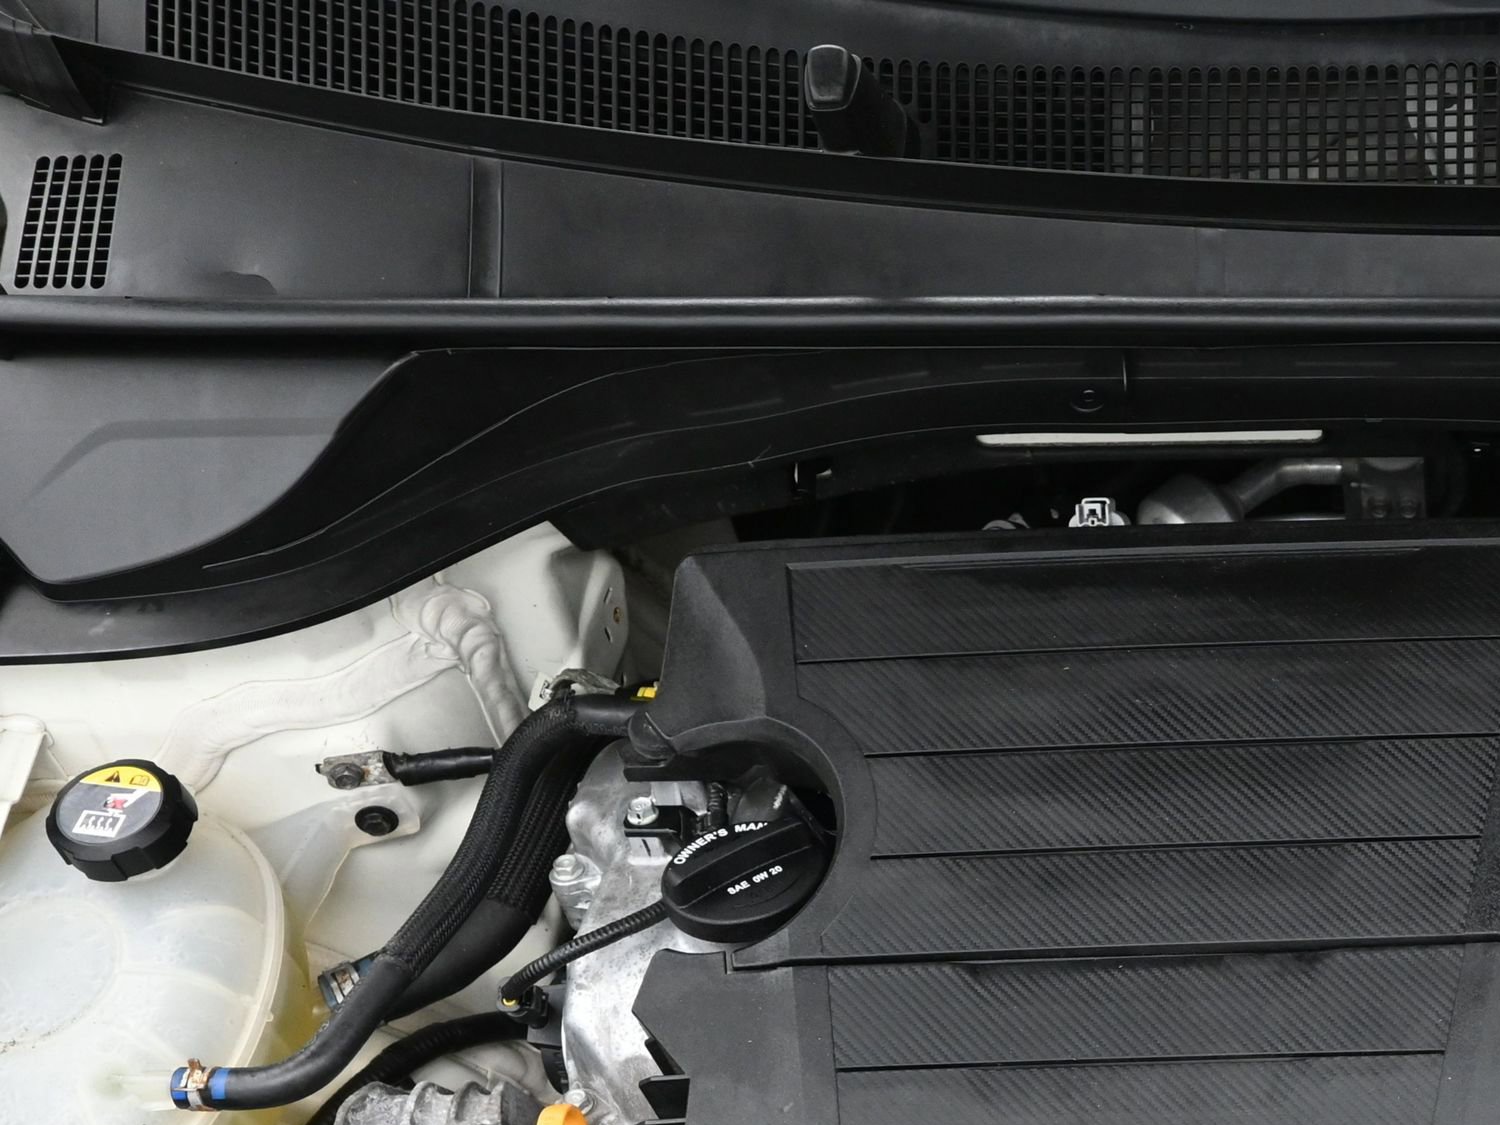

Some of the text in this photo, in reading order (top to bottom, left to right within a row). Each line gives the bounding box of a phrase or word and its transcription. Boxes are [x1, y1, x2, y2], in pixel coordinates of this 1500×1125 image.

[673, 828, 728, 865] OWNER'S
[726, 880, 751, 895] SAE
[769, 865, 784, 876] 20
